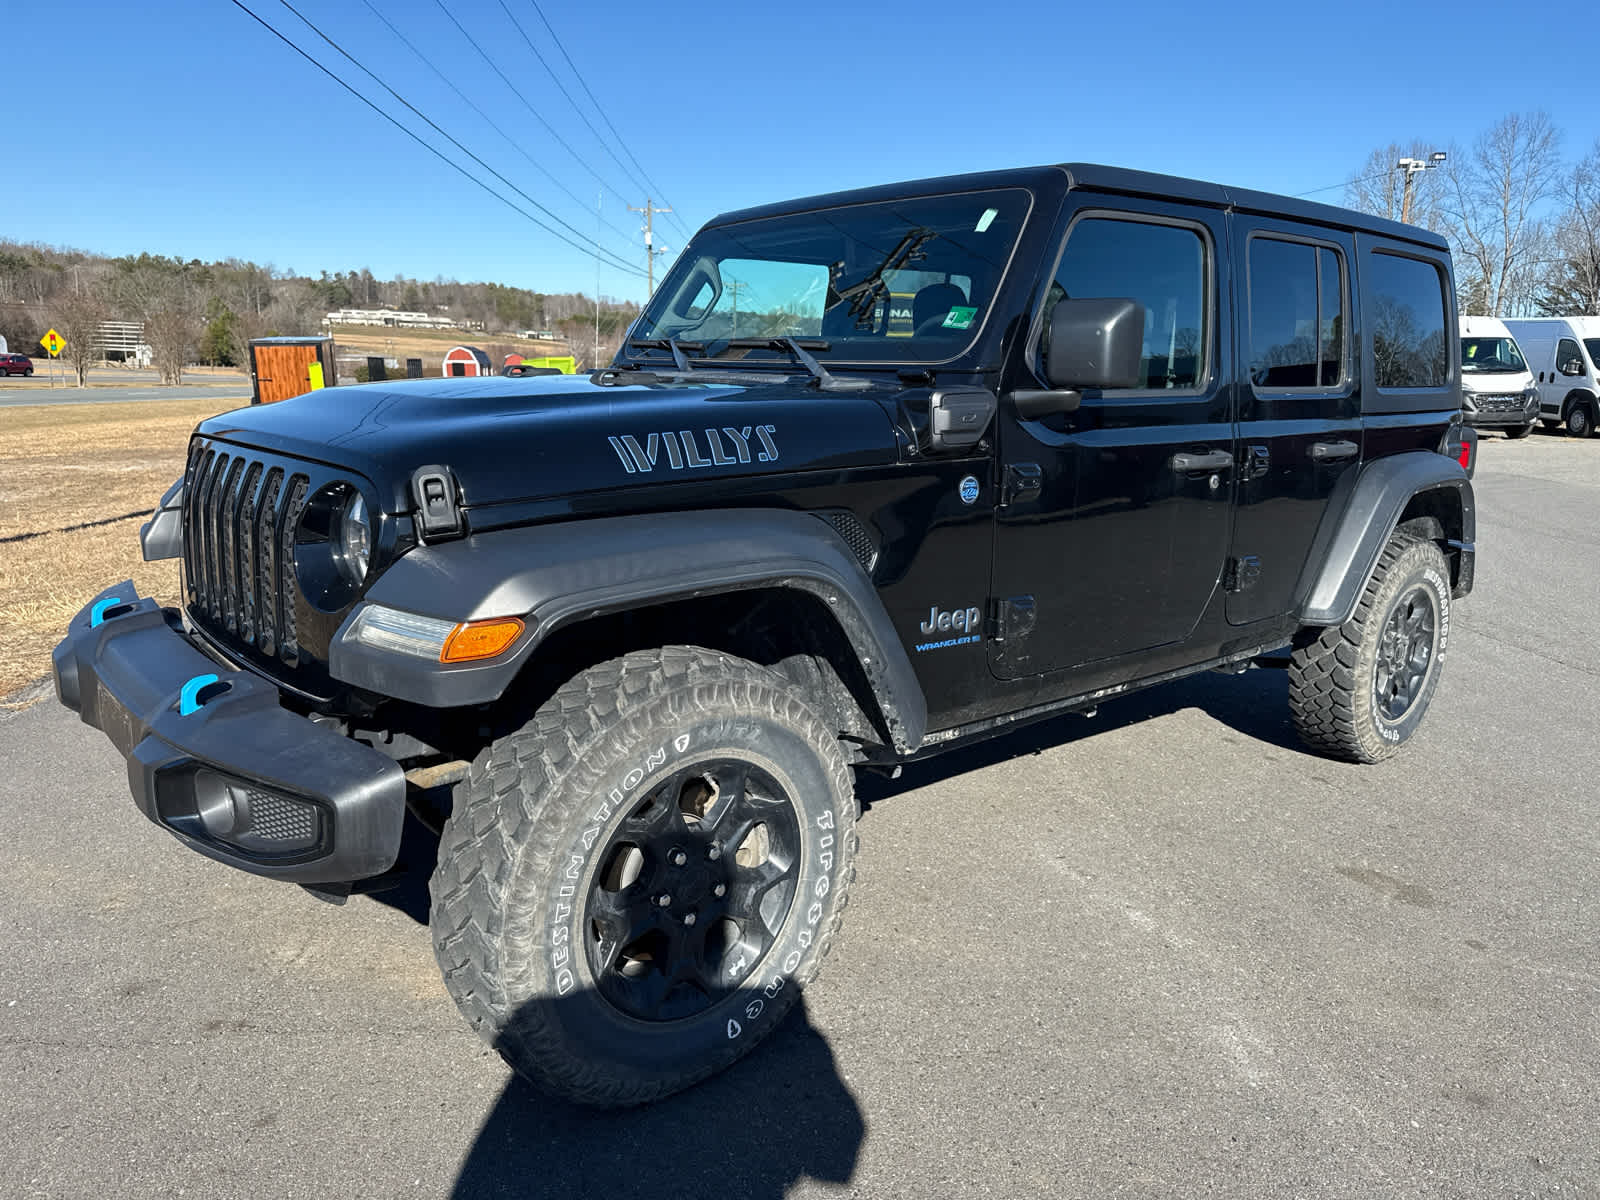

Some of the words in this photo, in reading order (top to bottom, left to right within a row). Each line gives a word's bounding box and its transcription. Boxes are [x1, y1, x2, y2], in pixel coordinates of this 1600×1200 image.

[608, 425, 779, 474] WILLYS
[920, 606, 981, 635] Jeep
[915, 637, 971, 653] WRANGLER
[552, 747, 666, 996] DESTINATION
